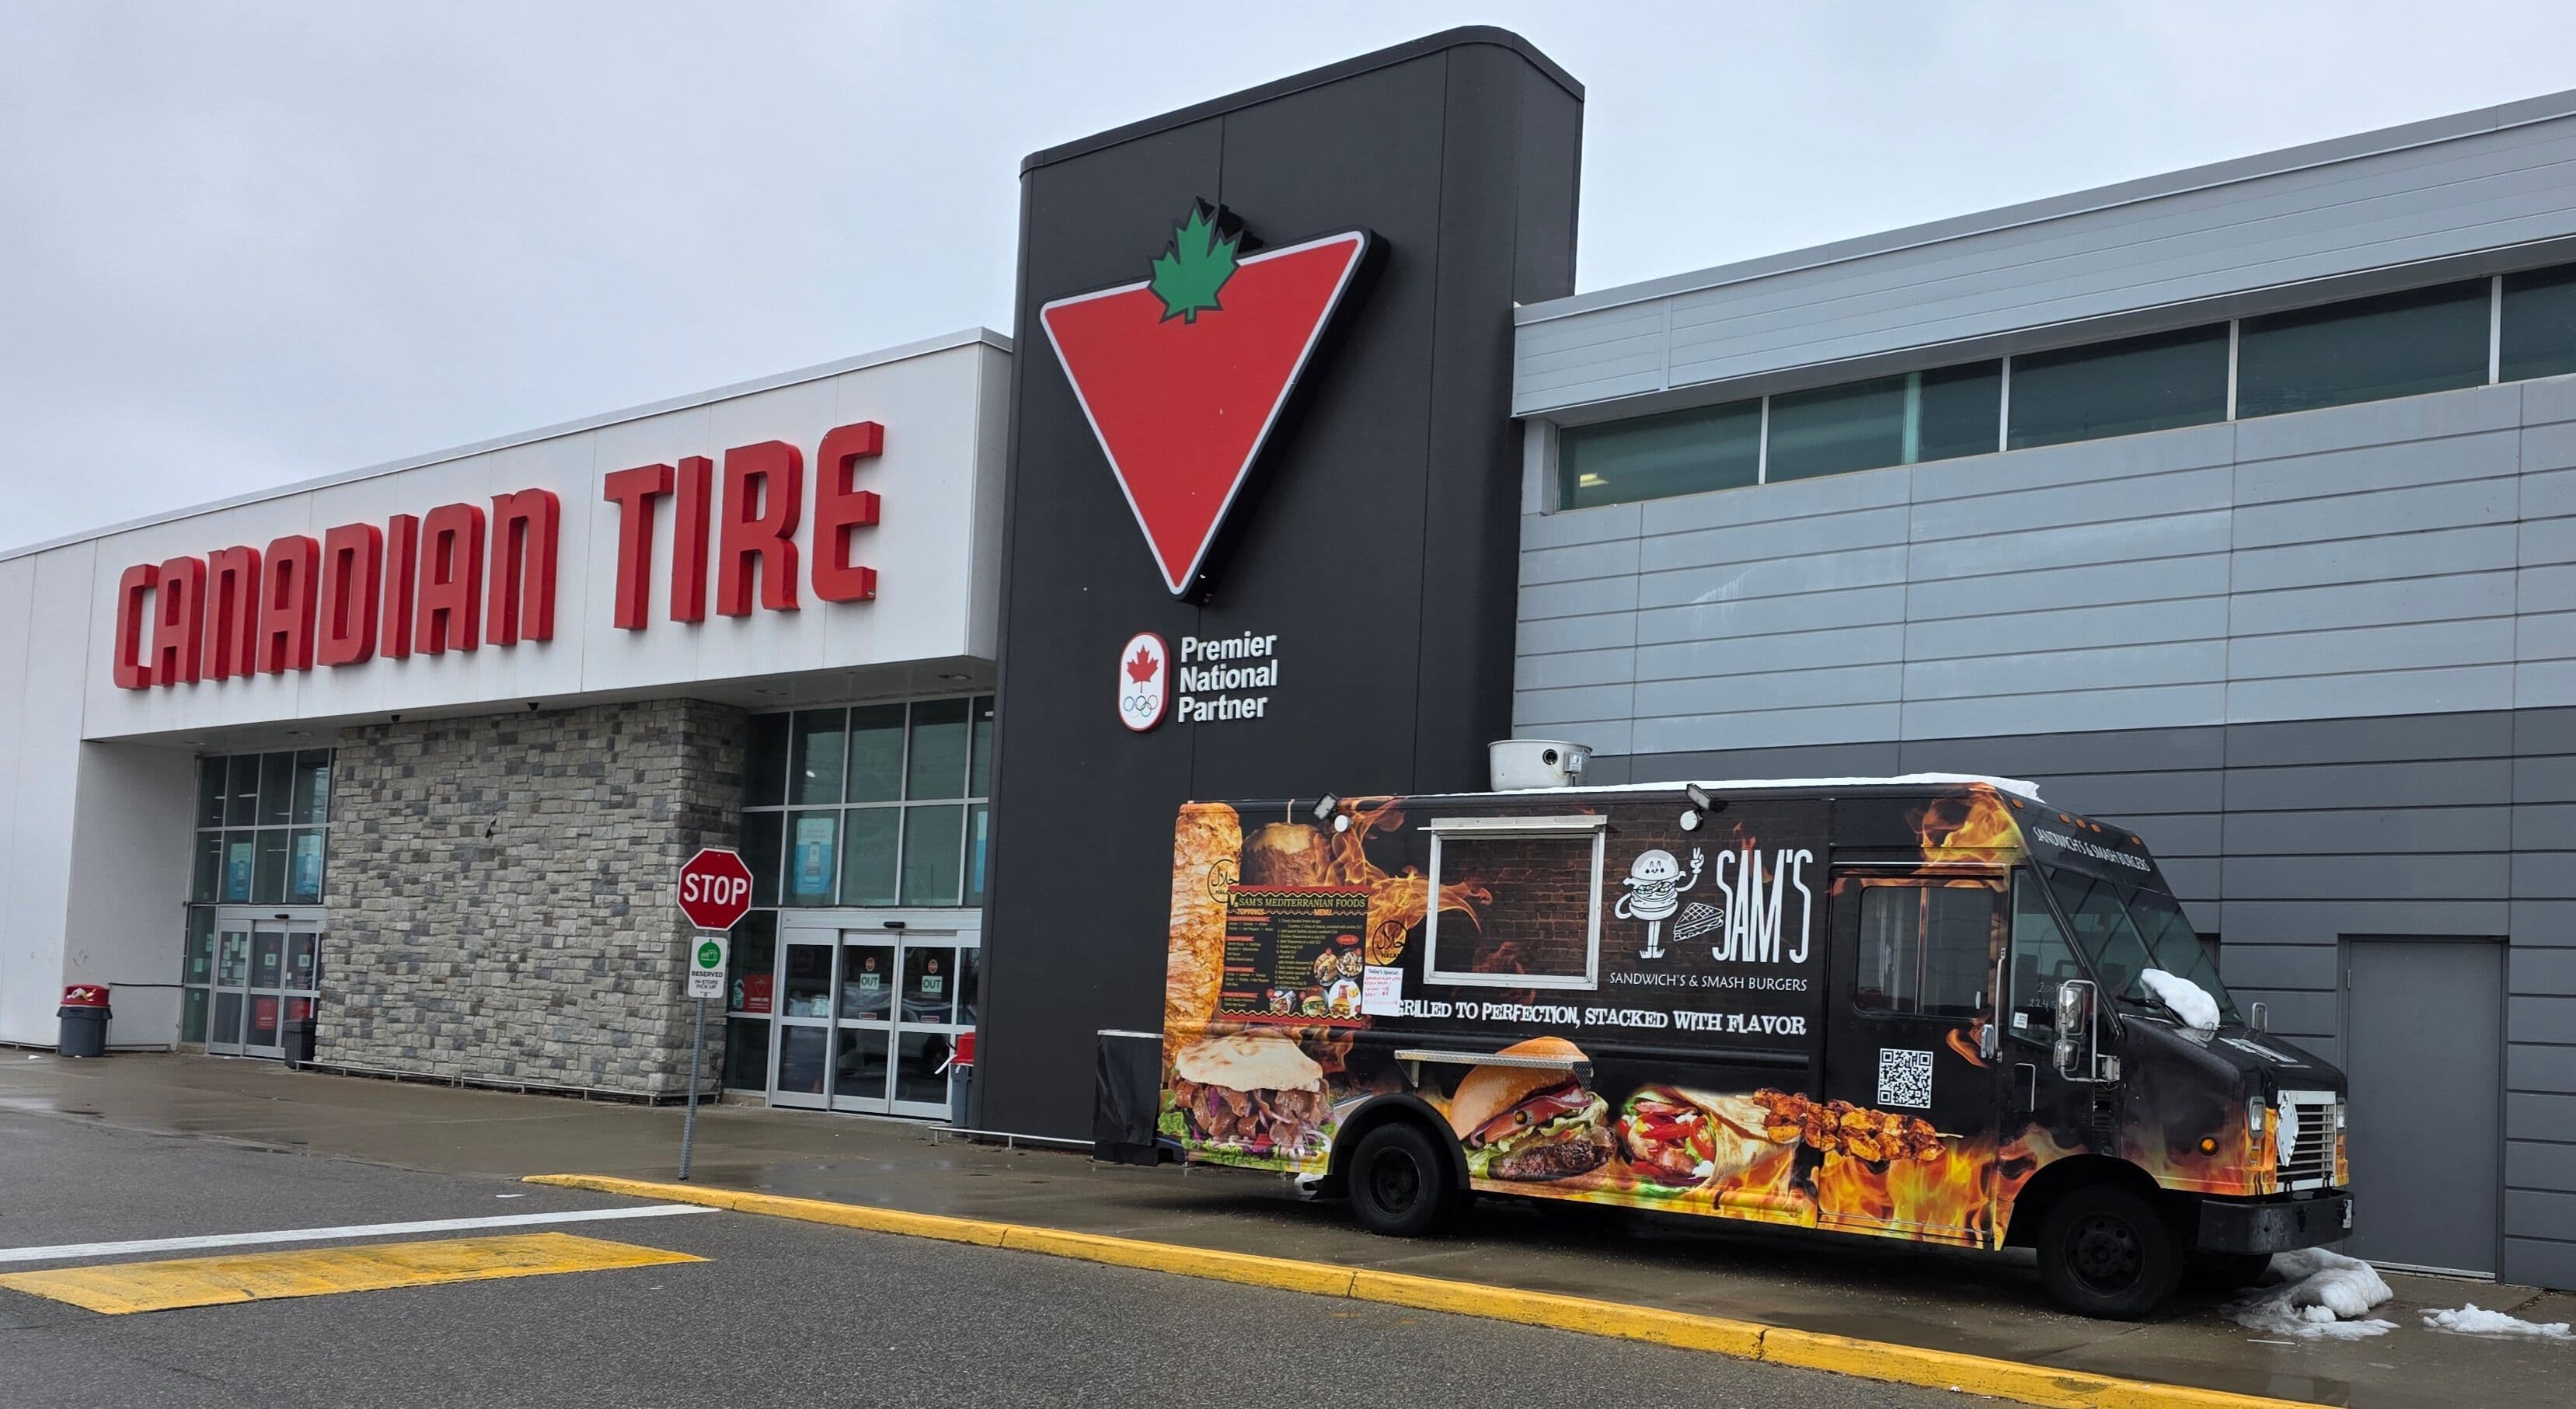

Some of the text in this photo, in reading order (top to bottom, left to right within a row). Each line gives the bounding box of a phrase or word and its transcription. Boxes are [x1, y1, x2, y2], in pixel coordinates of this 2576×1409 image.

[113, 420, 884, 689] CANADIAN TIRE
[1181, 631, 1278, 662] Premier
[1180, 659, 1278, 692] National
[1178, 694, 1268, 722] Partner
[2090, 844, 2120, 863] SMASH
[2115, 851, 2150, 872] BURGERS
[683, 873, 748, 905] STOP
[1239, 898, 1365, 908] SAM'S MEDITERRANIAN FOODS
[1712, 849, 1814, 963] SAM'S
[861, 977, 879, 986] OUT
[922, 979, 941, 989] OUT
[1609, 972, 1807, 992] SANDWICH'S & SMASH BURGERS
[1455, 1002, 1478, 1019] TO
[1482, 1003, 1581, 1029] PERFECTION,
[1584, 1008, 1668, 1028] STACKED
[1672, 1010, 1723, 1031] WITH
[1726, 1013, 1807, 1035] FLAVOR
